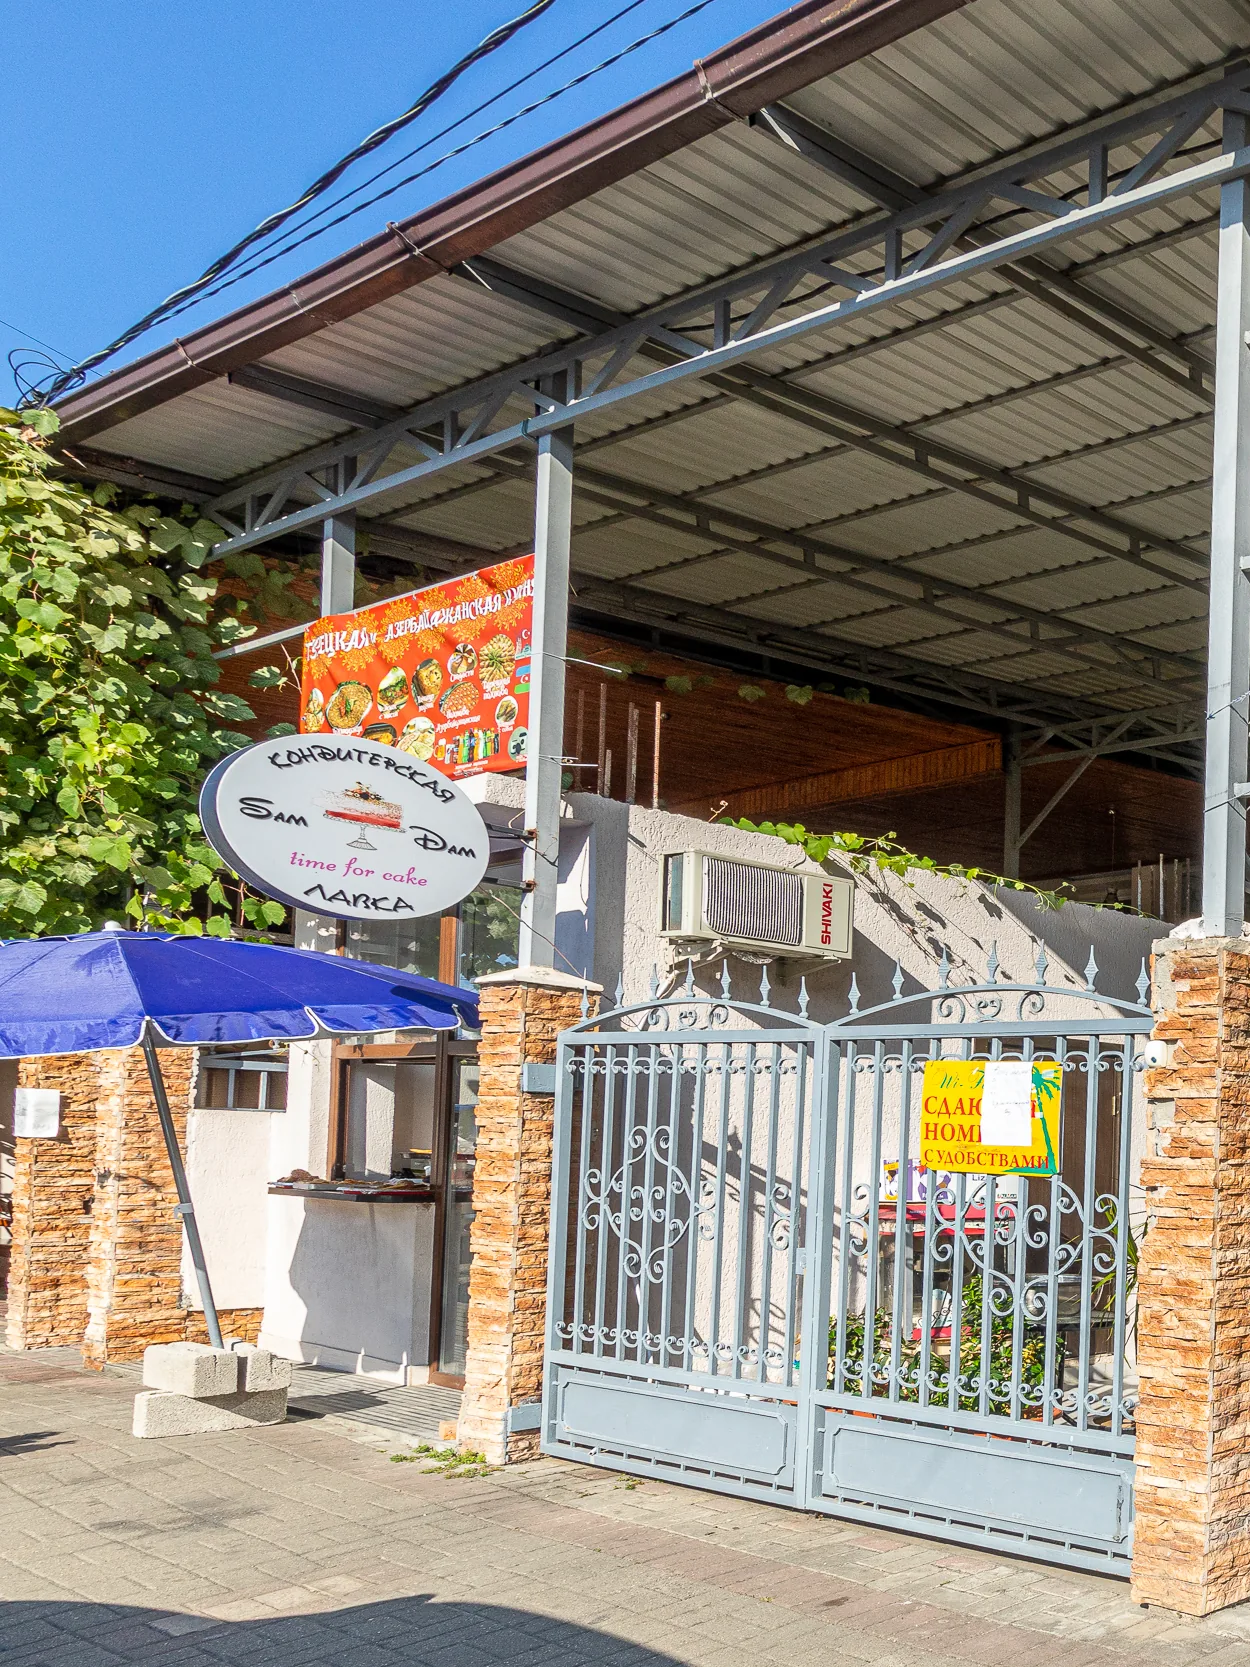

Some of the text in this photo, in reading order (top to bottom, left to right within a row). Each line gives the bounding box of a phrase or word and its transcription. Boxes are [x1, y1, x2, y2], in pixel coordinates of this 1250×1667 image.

[267, 744, 456, 804] КОНДИТЕРСКАЯ
[290, 851, 428, 887] time for cake
[303, 883, 415, 912] ЛАВКА
[820, 882, 833, 945] SHIVAKI
[936, 1150, 1049, 1169] УДОБСТВАМИ
